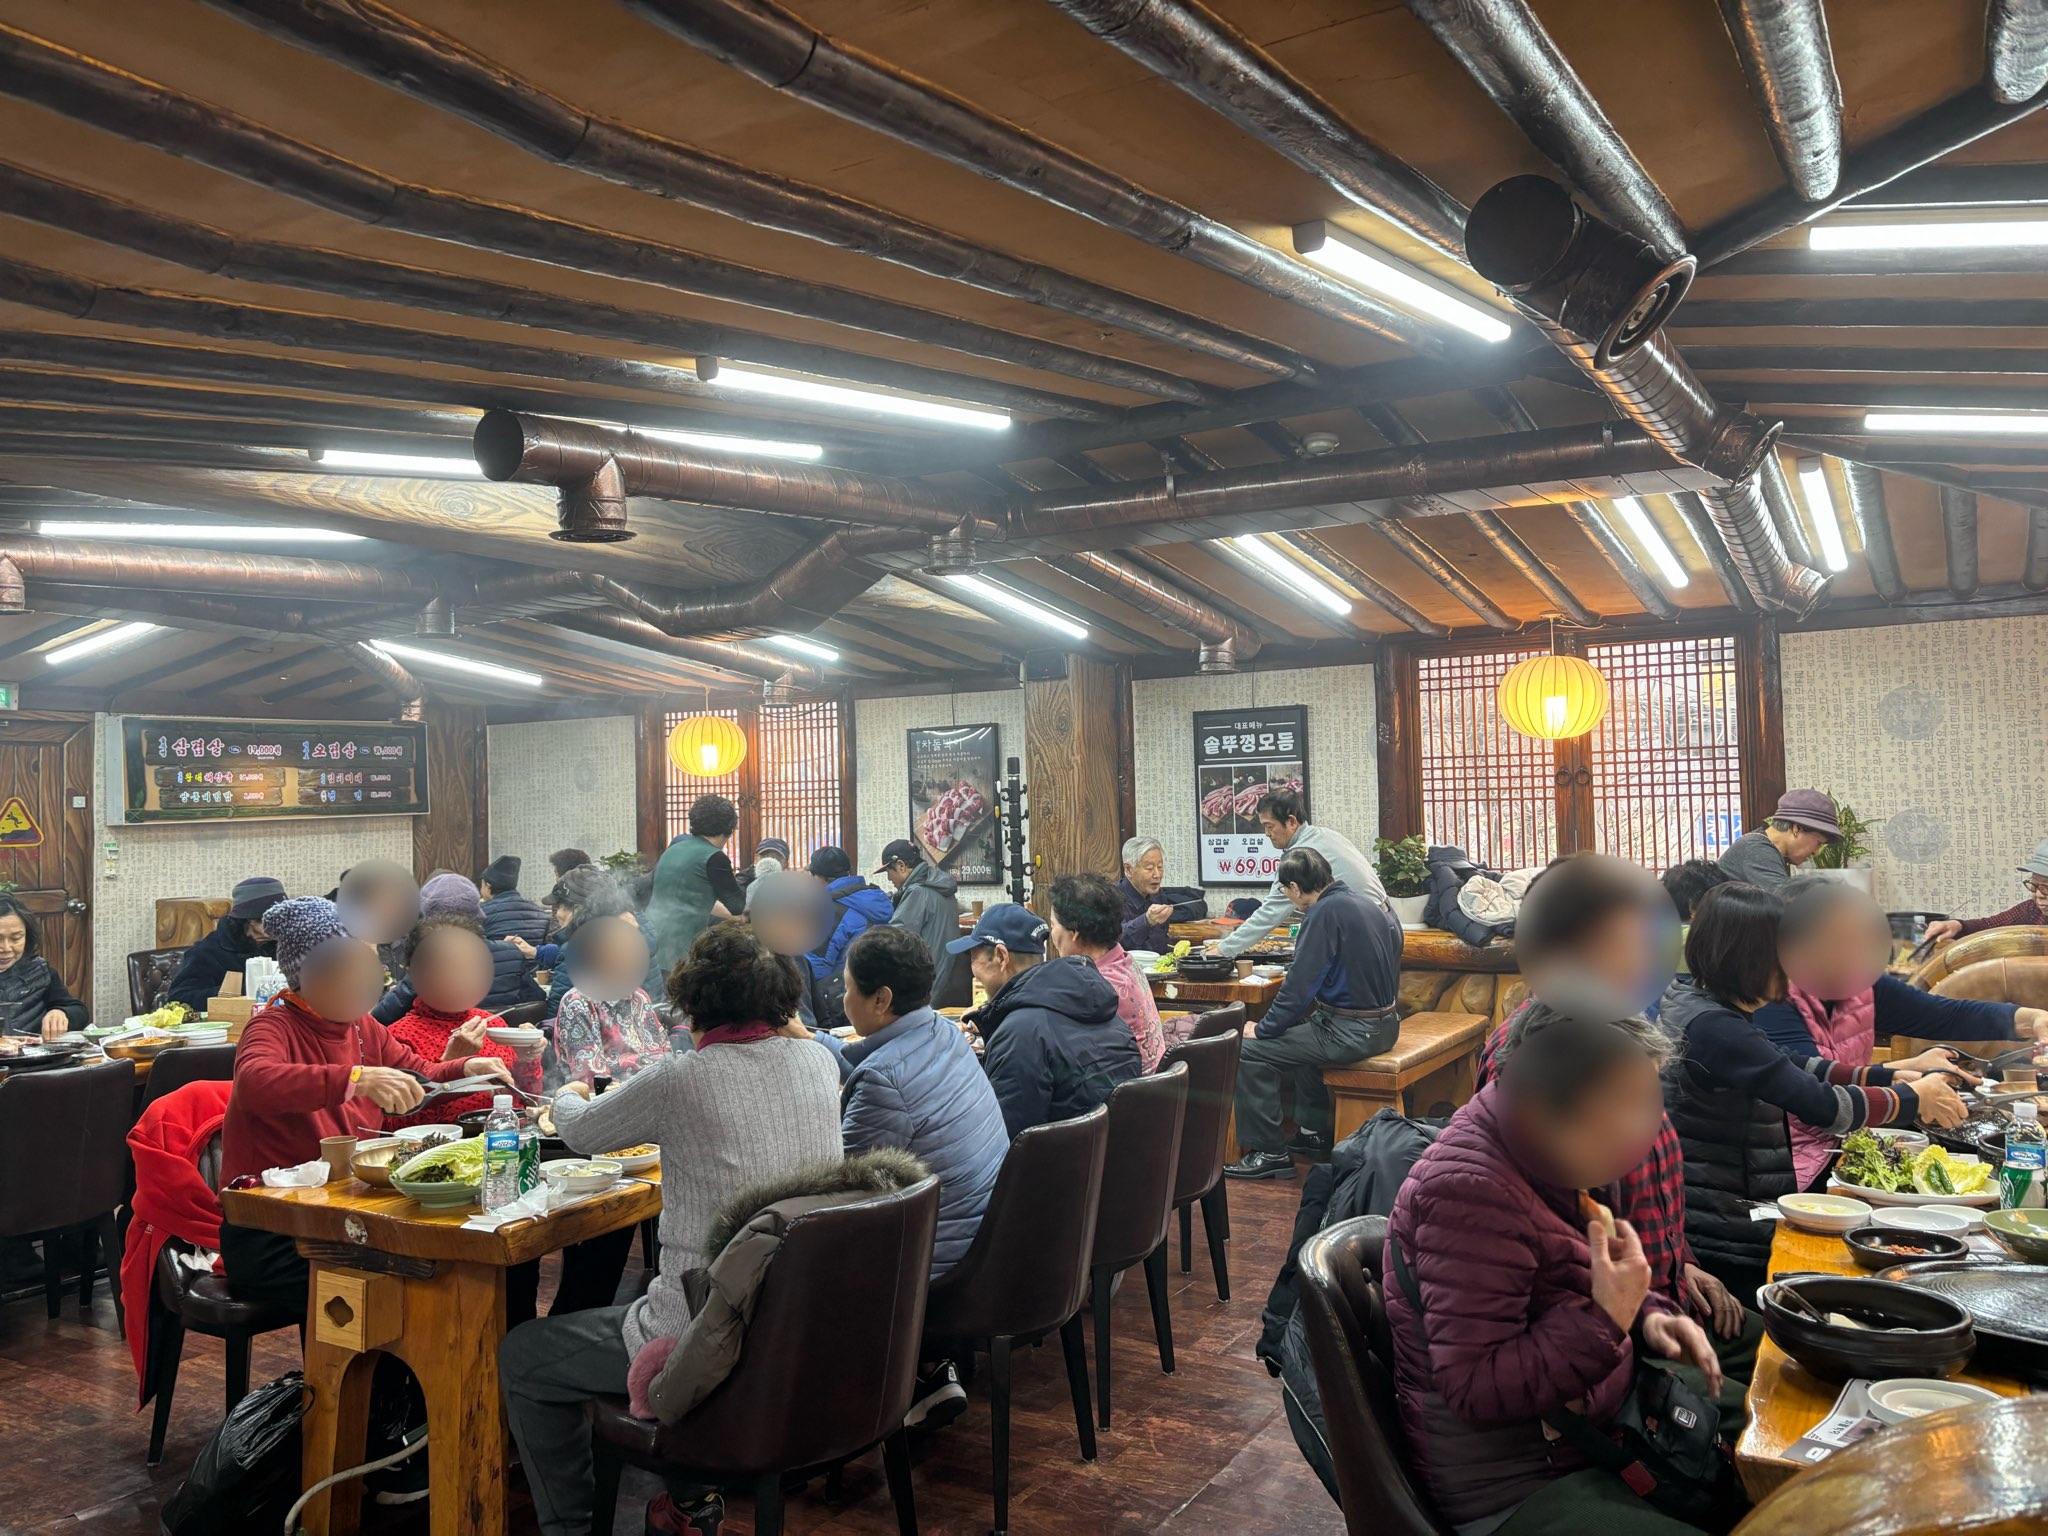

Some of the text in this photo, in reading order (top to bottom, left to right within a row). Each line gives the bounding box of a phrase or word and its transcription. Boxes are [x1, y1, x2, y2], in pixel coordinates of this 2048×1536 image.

[1234, 721, 1263, 730] 대표메뉴
[171, 737, 225, 757] 삼겹살
[312, 741, 357, 760] 오겹살
[1203, 731, 1295, 755] 솥뚜껑모듬
[1207, 837, 1230, 846] 삼겹살
[1241, 836, 1264, 846] 오겹살
[1218, 857, 1281, 877] ₩69,00
